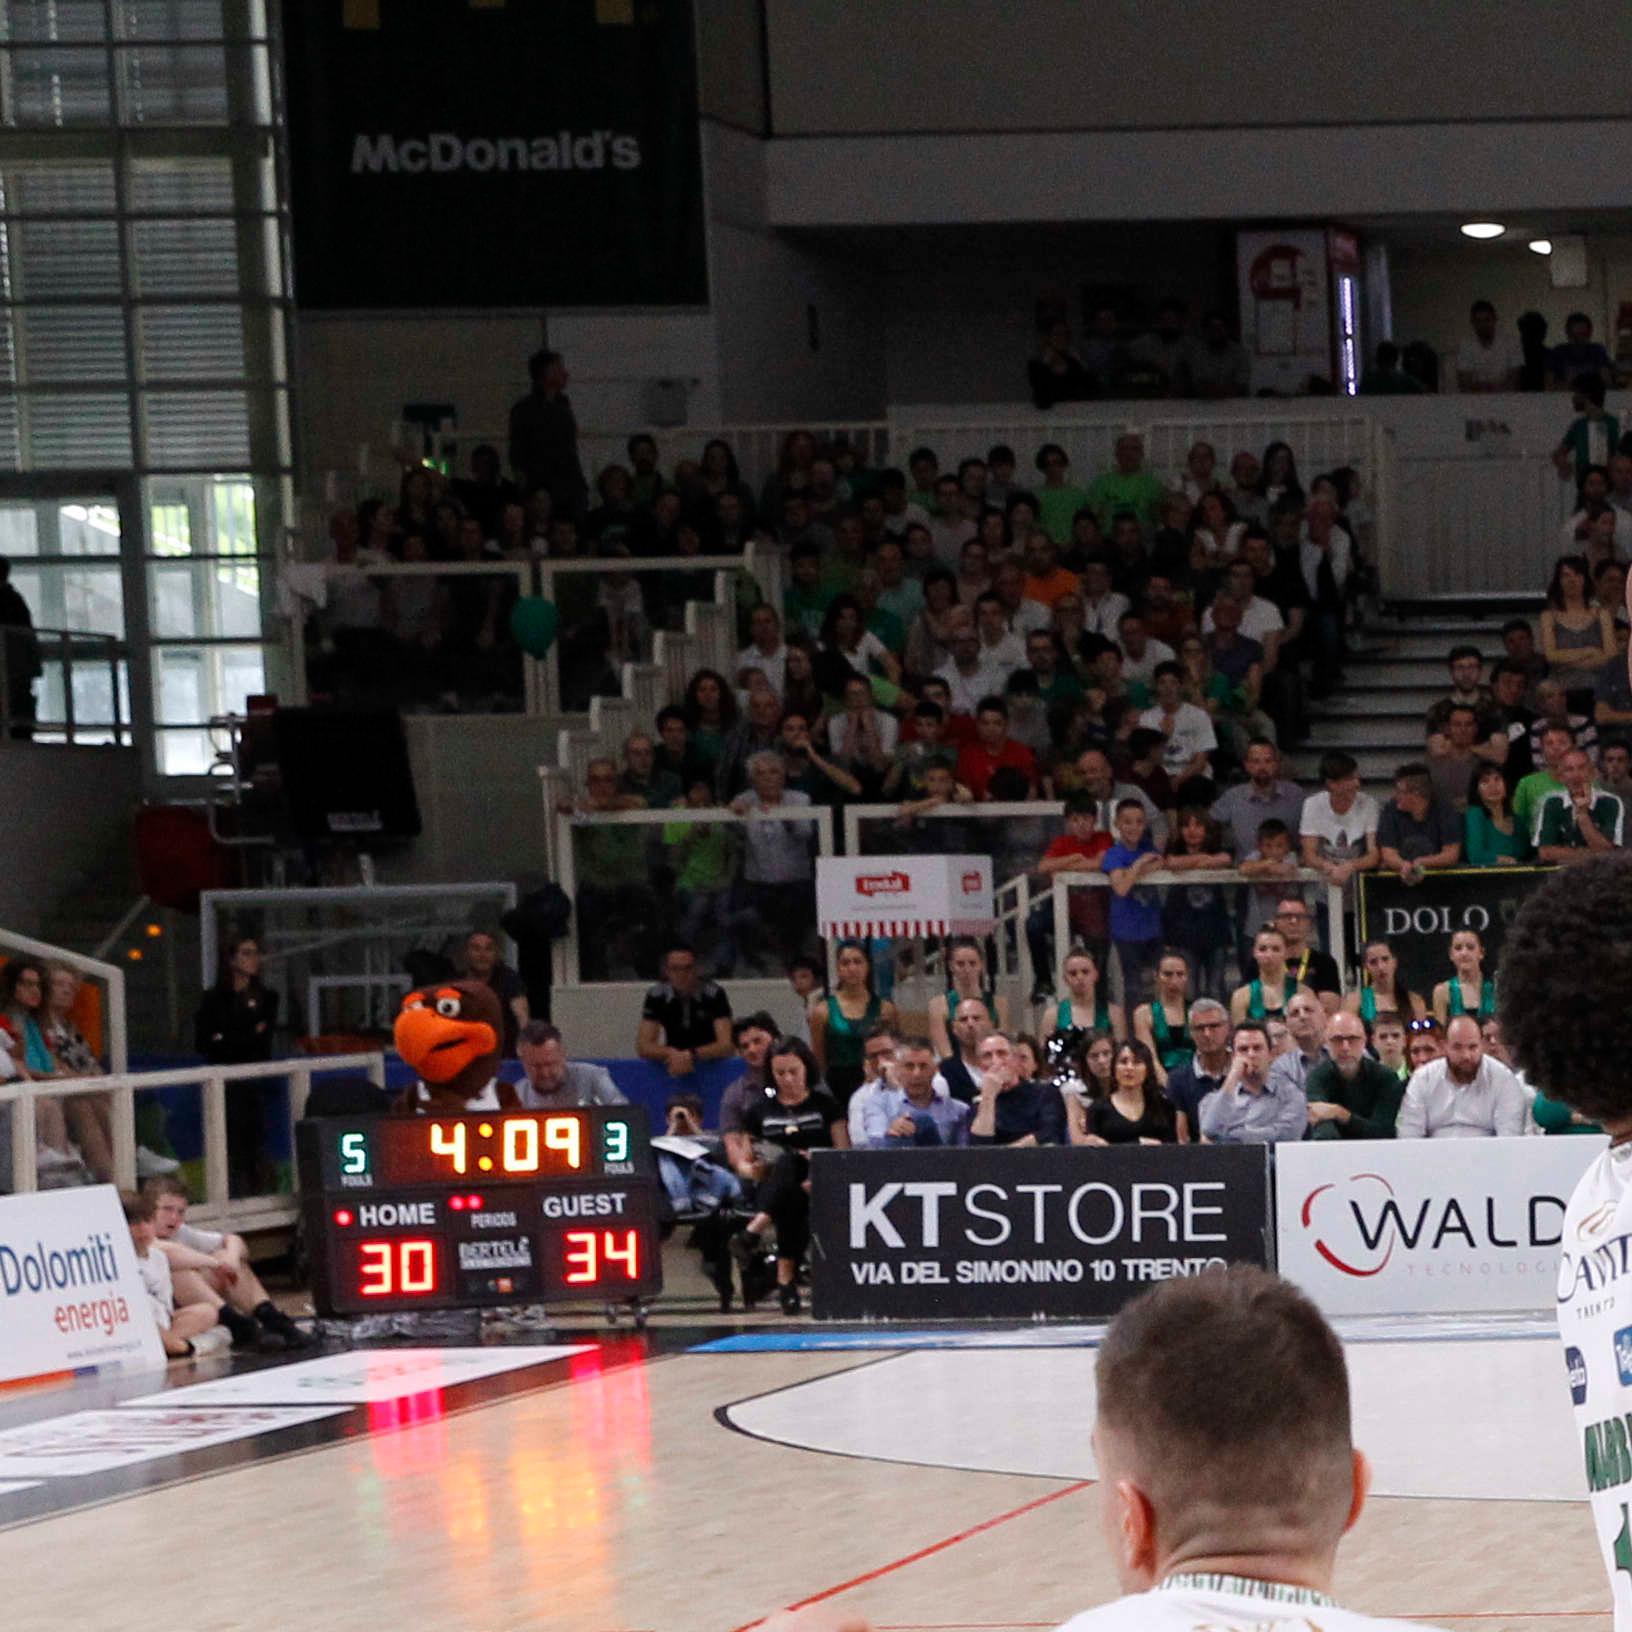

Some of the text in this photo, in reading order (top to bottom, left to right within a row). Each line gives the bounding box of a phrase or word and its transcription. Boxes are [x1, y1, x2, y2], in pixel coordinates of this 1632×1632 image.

[351, 129, 643, 174] McDonald's
[429, 1117, 582, 1175] 4:09
[606, 1121, 629, 1162] 3
[359, 1192, 628, 1227] HOME GUEST
[359, 1230, 639, 1295] 30 34
[851, 1261, 896, 1286] VIA
[899, 1260, 950, 1285] DEL
[955, 1258, 1085, 1284] SIMONINO
[1090, 1258, 1116, 1282] 10
[54, 1290, 130, 1336] energia
